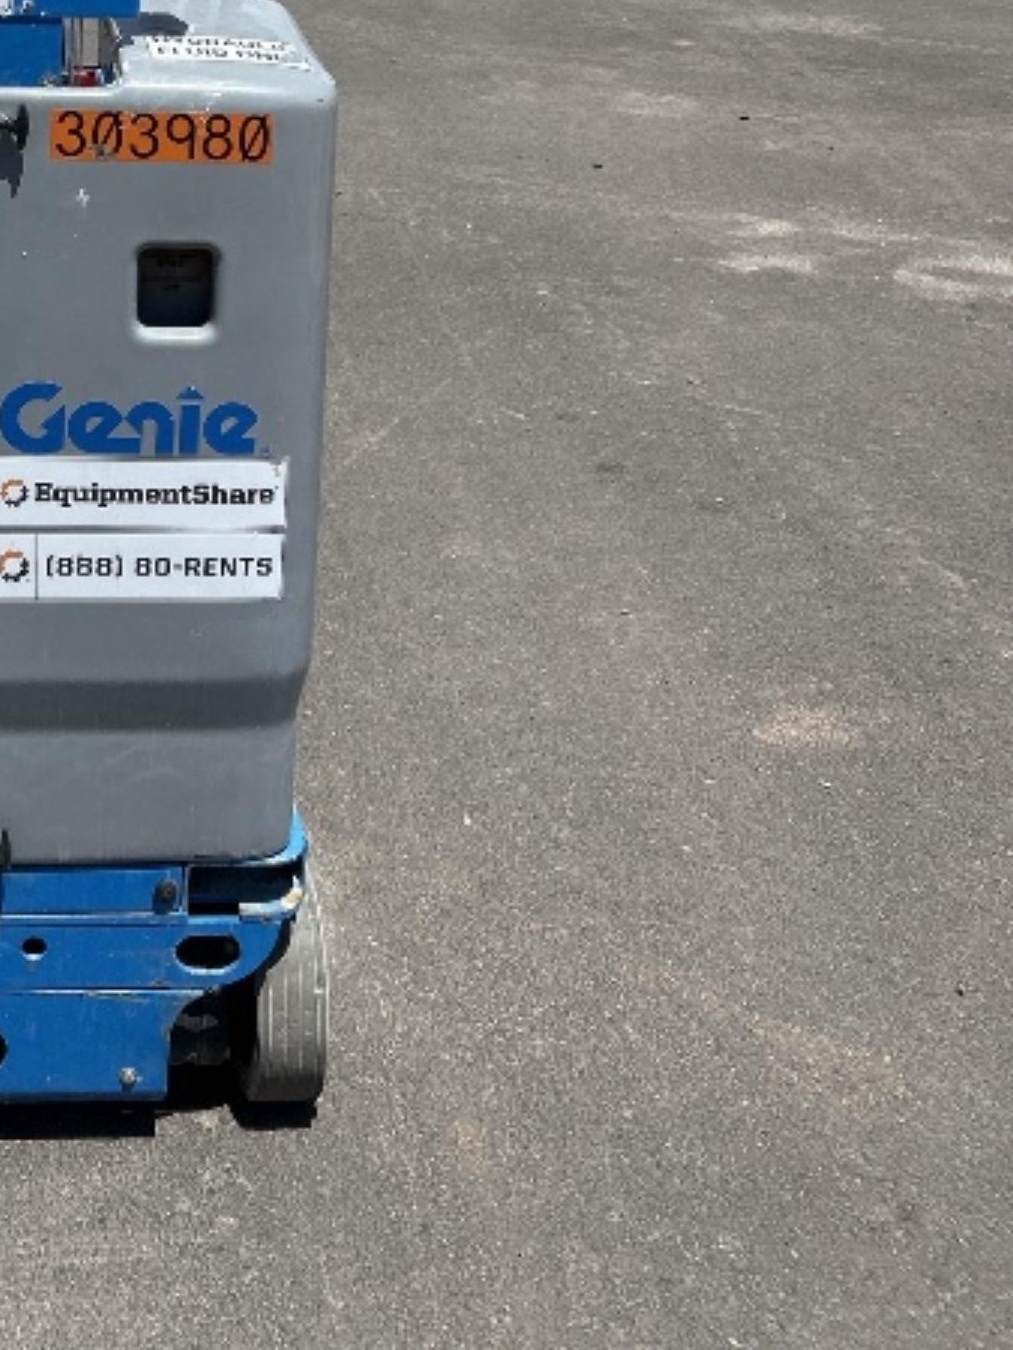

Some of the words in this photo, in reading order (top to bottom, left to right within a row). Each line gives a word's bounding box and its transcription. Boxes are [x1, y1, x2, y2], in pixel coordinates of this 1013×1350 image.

[55, 110, 271, 162] 303980
[34, 482, 275, 507] EquipmentShare
[45, 554, 123, 577] (888)
[134, 556, 273, 578] 80-RENTS
